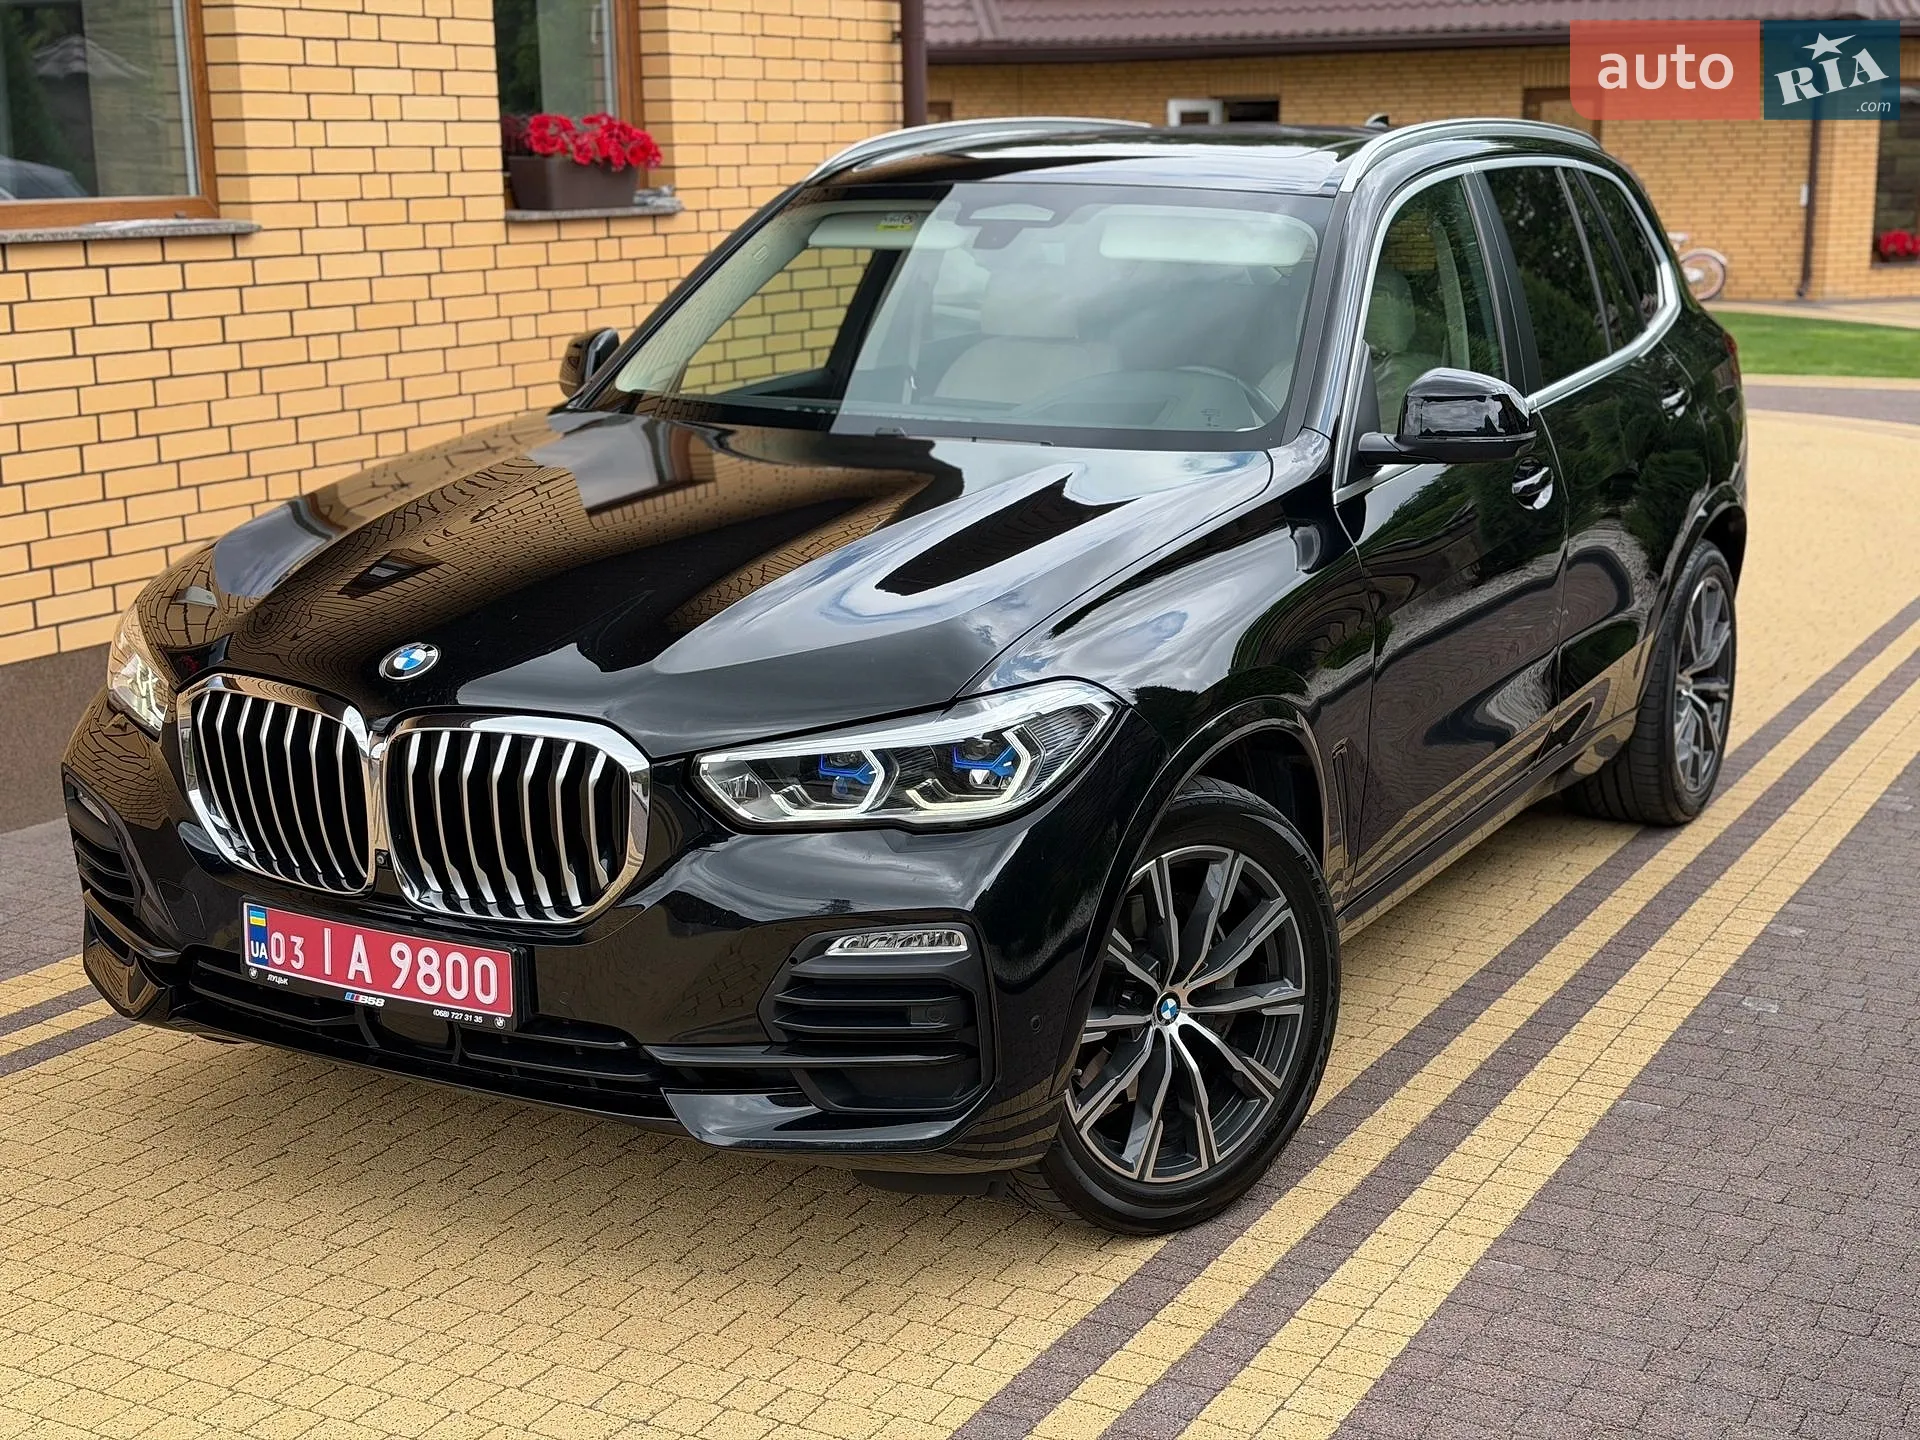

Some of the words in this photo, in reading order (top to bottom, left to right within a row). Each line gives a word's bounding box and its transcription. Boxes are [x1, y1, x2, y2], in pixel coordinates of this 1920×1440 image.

[250, 940, 269, 960] UA
[270, 931, 305, 970] 03
[390, 942, 498, 1005] 9800
[450, 1012, 463, 1020] 727
[473, 1015, 483, 1023] 35
